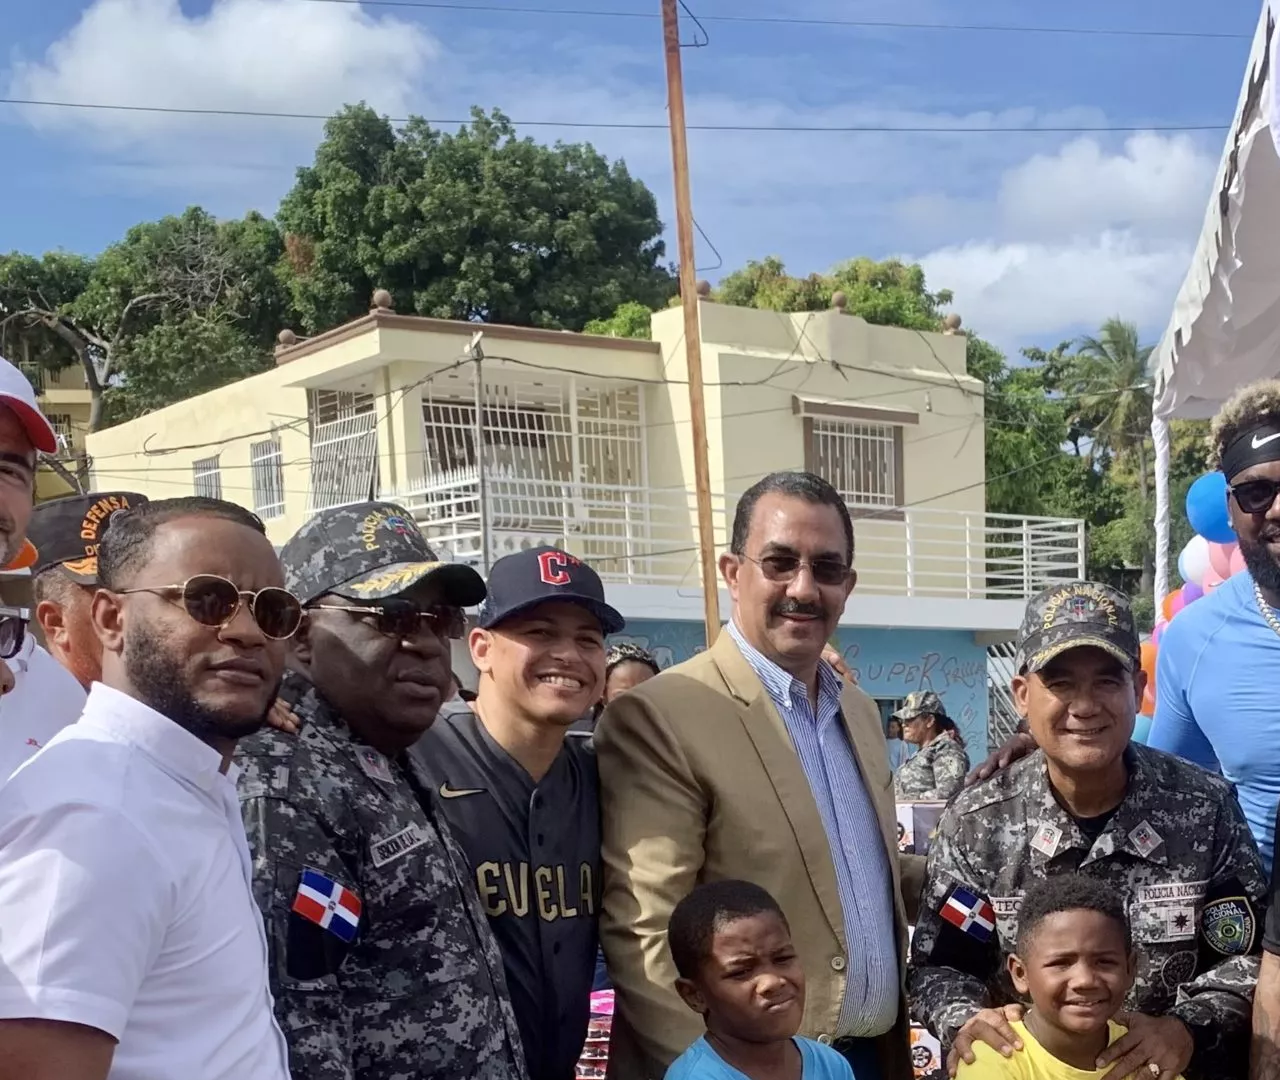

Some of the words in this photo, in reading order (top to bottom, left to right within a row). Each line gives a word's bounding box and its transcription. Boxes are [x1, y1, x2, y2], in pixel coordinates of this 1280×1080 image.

[81, 496, 130, 539] DEFENSA
[537, 552, 571, 585] C
[1043, 590, 1071, 630] POLICIA
[1074, 587, 1119, 627] NACIONAL
[1144, 889, 1174, 899] POLICIA
